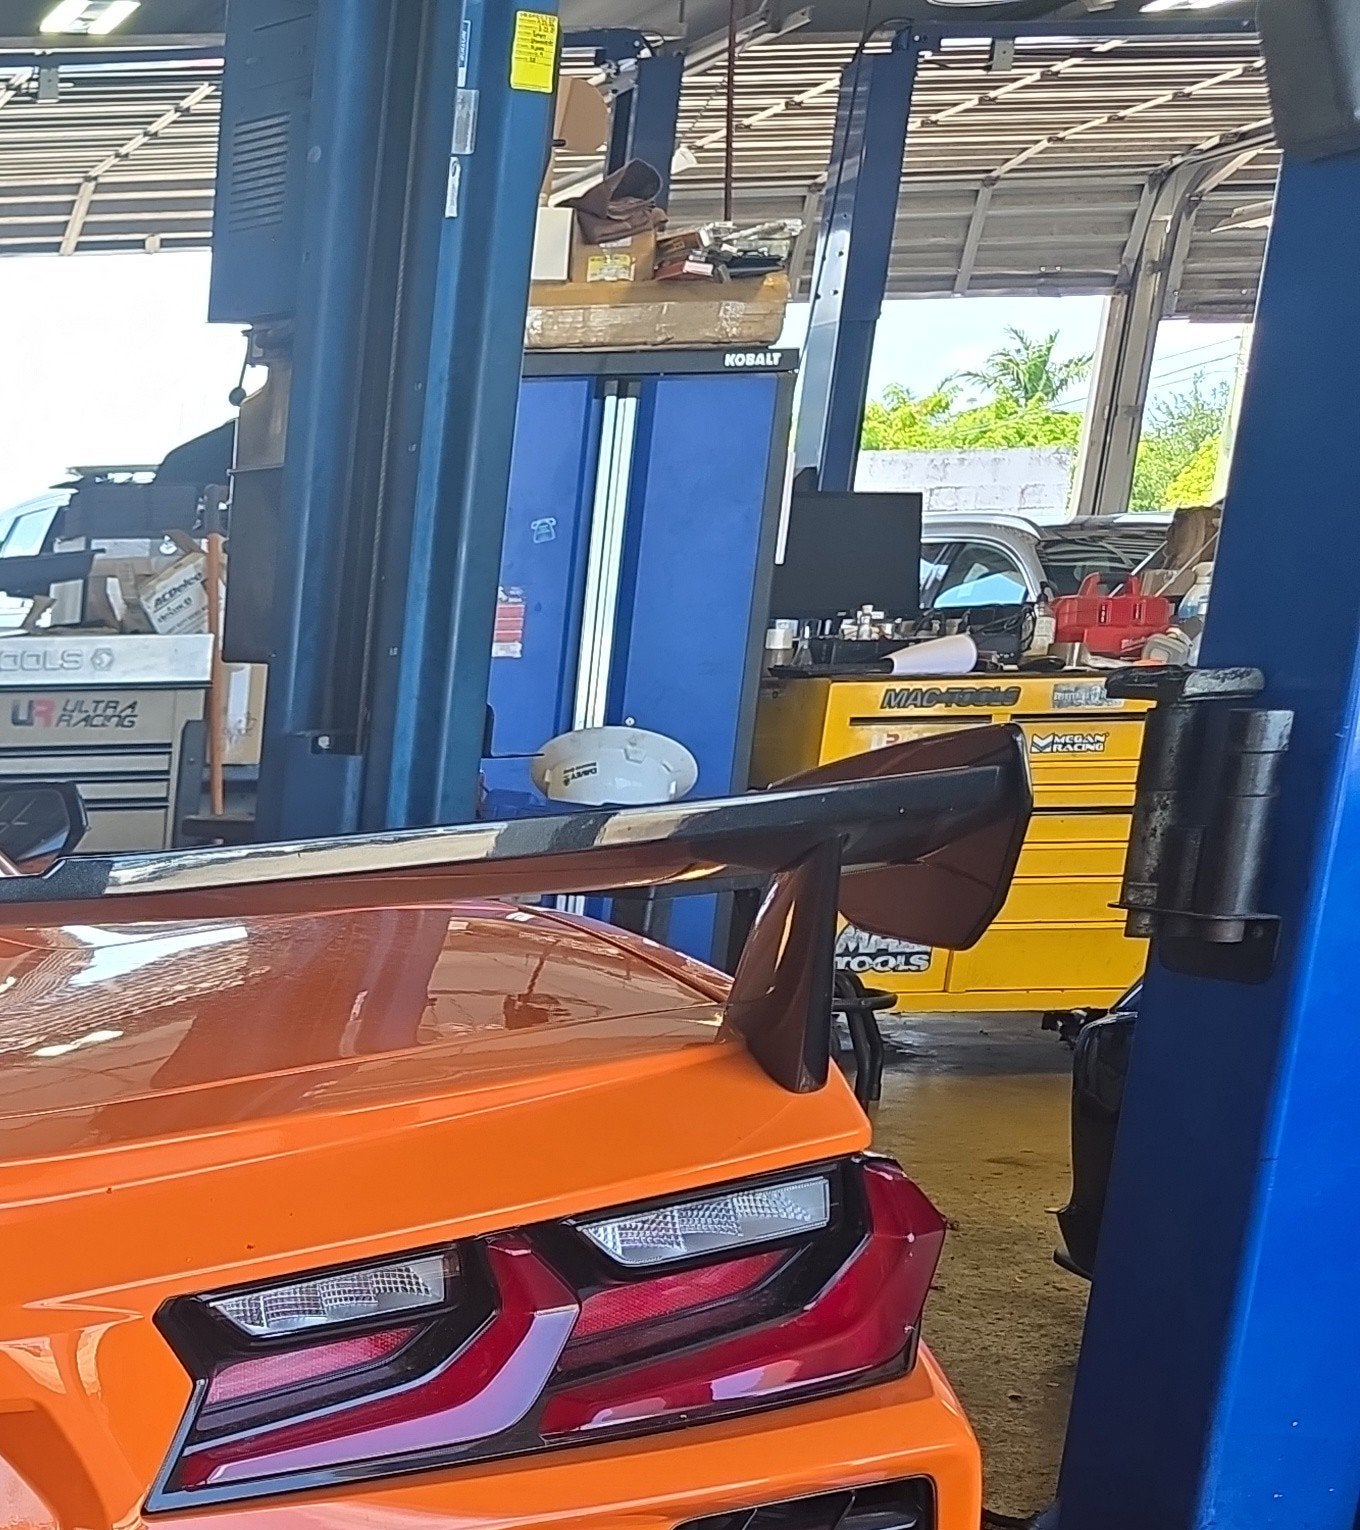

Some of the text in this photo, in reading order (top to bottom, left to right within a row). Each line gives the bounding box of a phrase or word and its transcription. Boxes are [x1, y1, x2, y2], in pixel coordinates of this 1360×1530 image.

[724, 352, 782, 367] KOBALT
[880, 686, 1022, 710] MAC TOOLS
[62, 699, 138, 714] ULTRA
[56, 713, 139, 729] RACING
[1053, 733, 1106, 744] MEGAN
[1052, 743, 1105, 753] RACING
[835, 954, 931, 971] TOOLS
